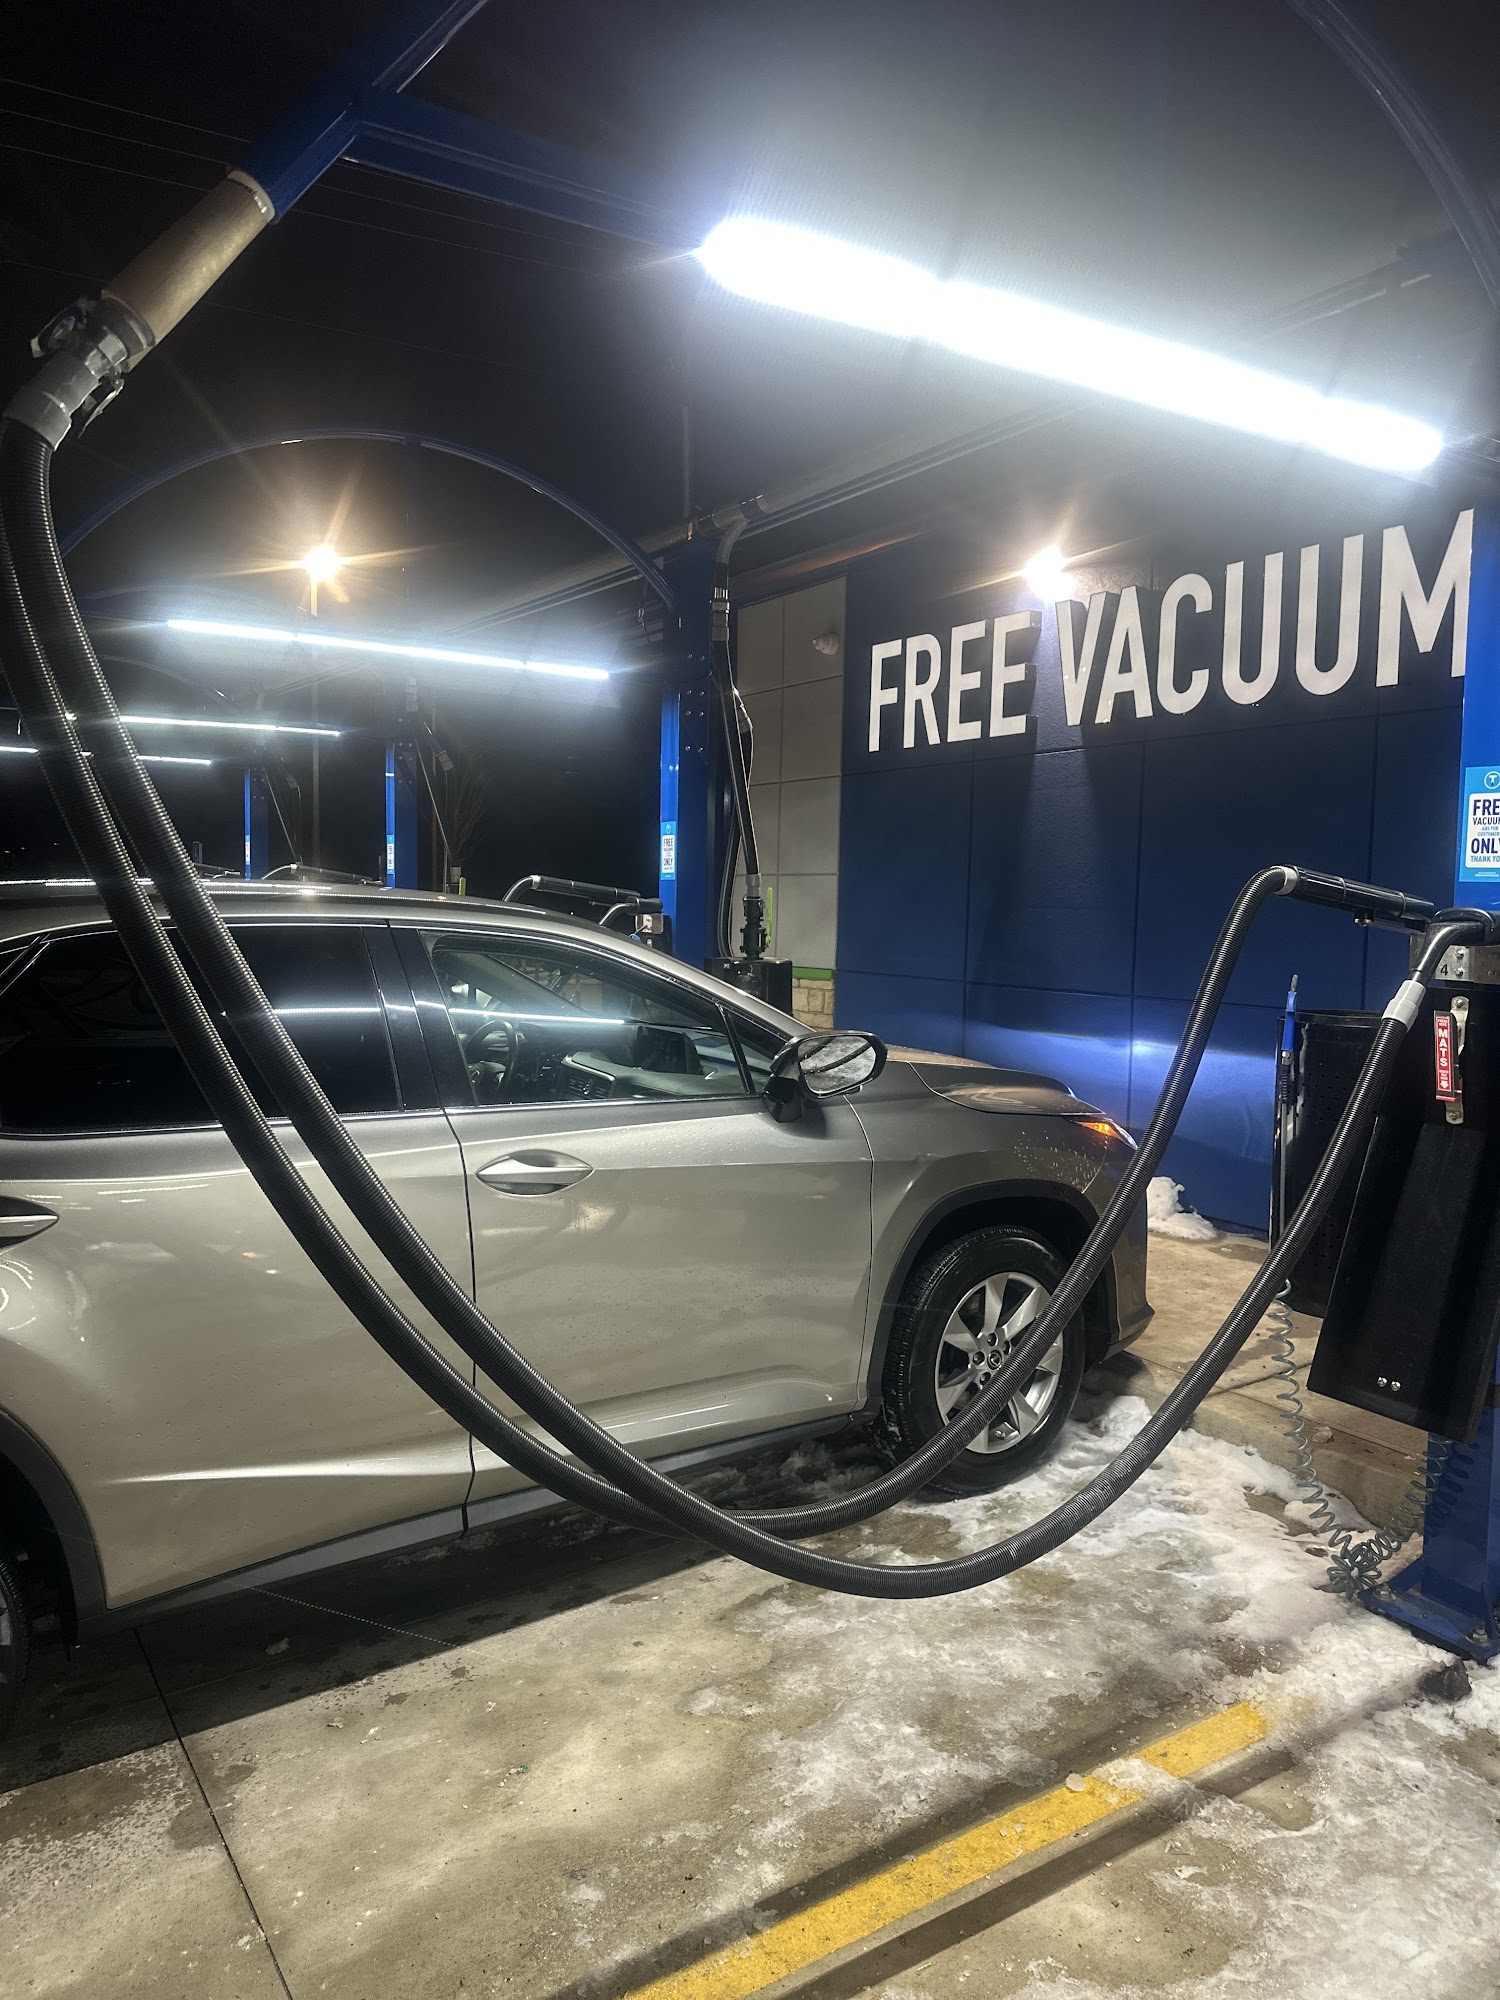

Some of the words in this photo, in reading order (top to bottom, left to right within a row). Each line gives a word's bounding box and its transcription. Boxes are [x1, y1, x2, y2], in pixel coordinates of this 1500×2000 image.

[869, 610, 1032, 752] FREE
[1055, 508, 1475, 726] VACUUM
[663, 838, 673, 847] FREE
[1470, 855, 1491, 863] THANK
[1440, 963, 1449, 976] 4
[1438, 1028, 1448, 1067] MATS
